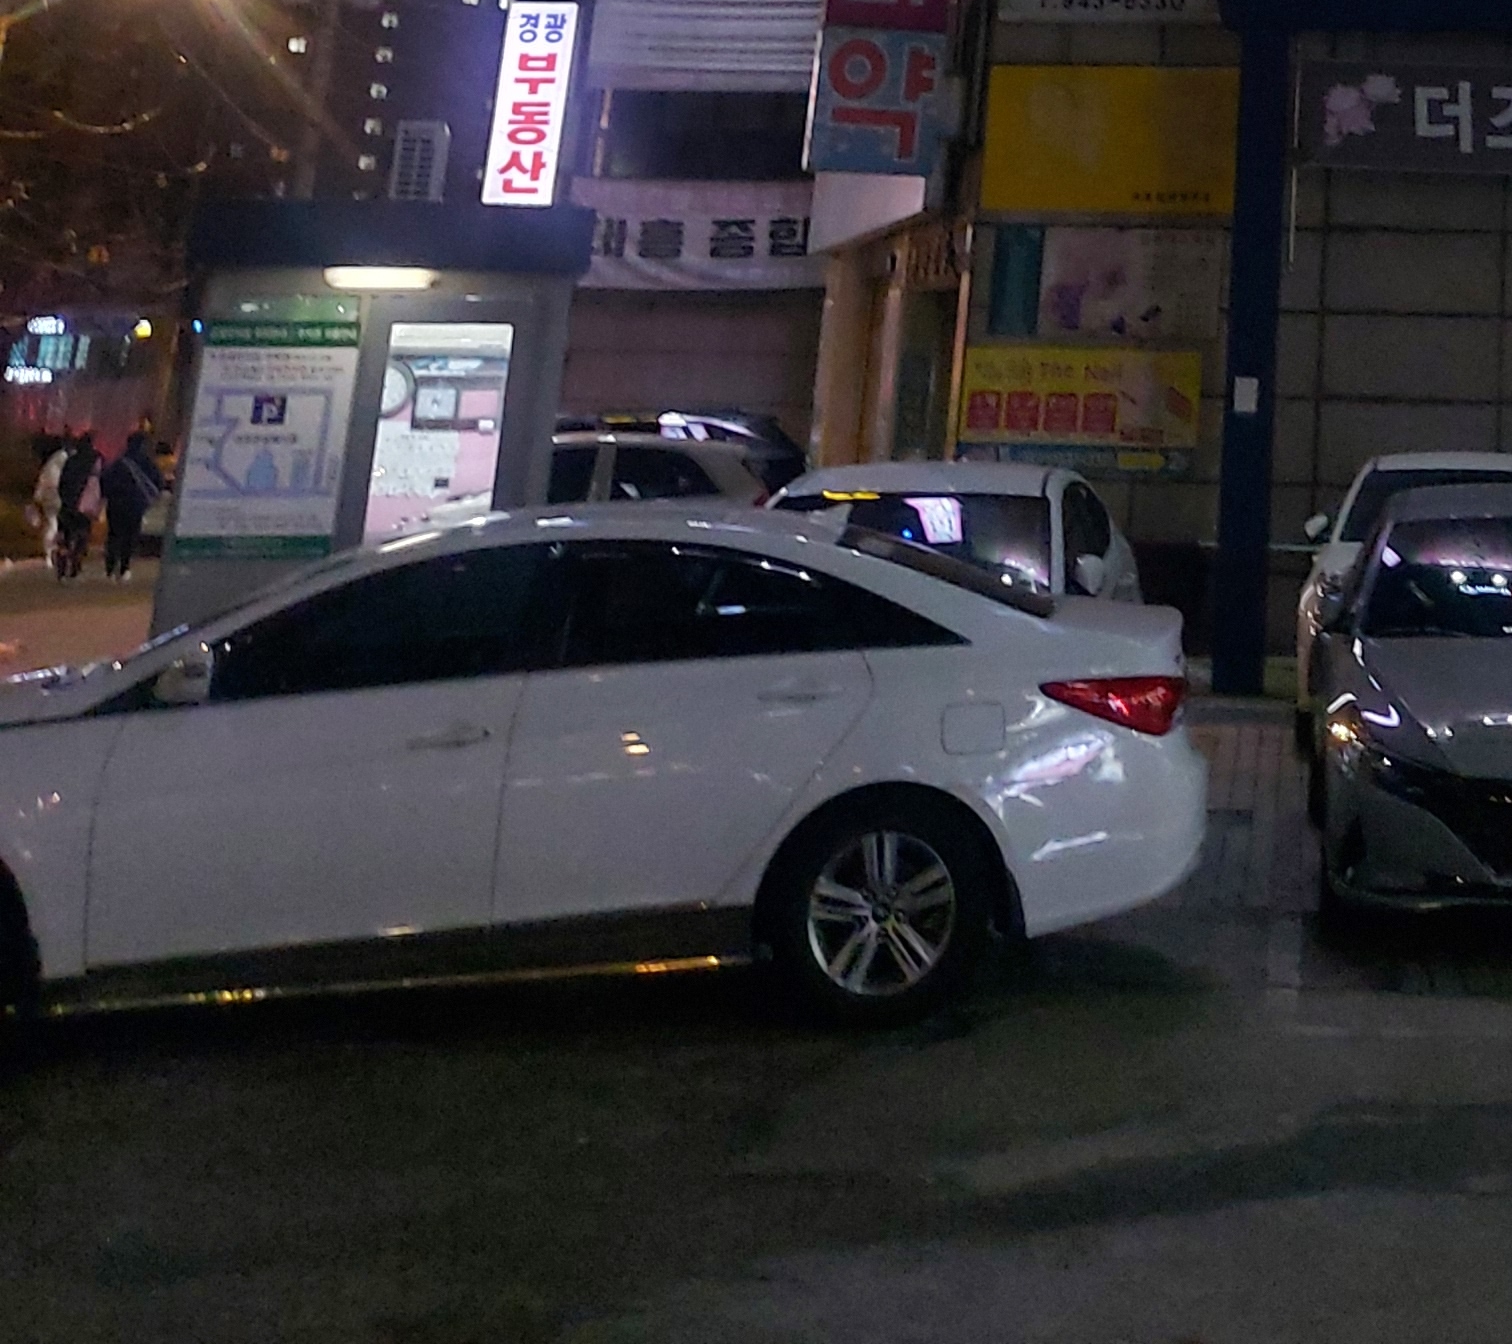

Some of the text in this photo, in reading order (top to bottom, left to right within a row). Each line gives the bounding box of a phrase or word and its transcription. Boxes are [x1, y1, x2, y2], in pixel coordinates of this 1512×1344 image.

[519, 13, 567, 44] 경광
[497, 52, 558, 196] 부동산
[828, 36, 937, 161] 약
